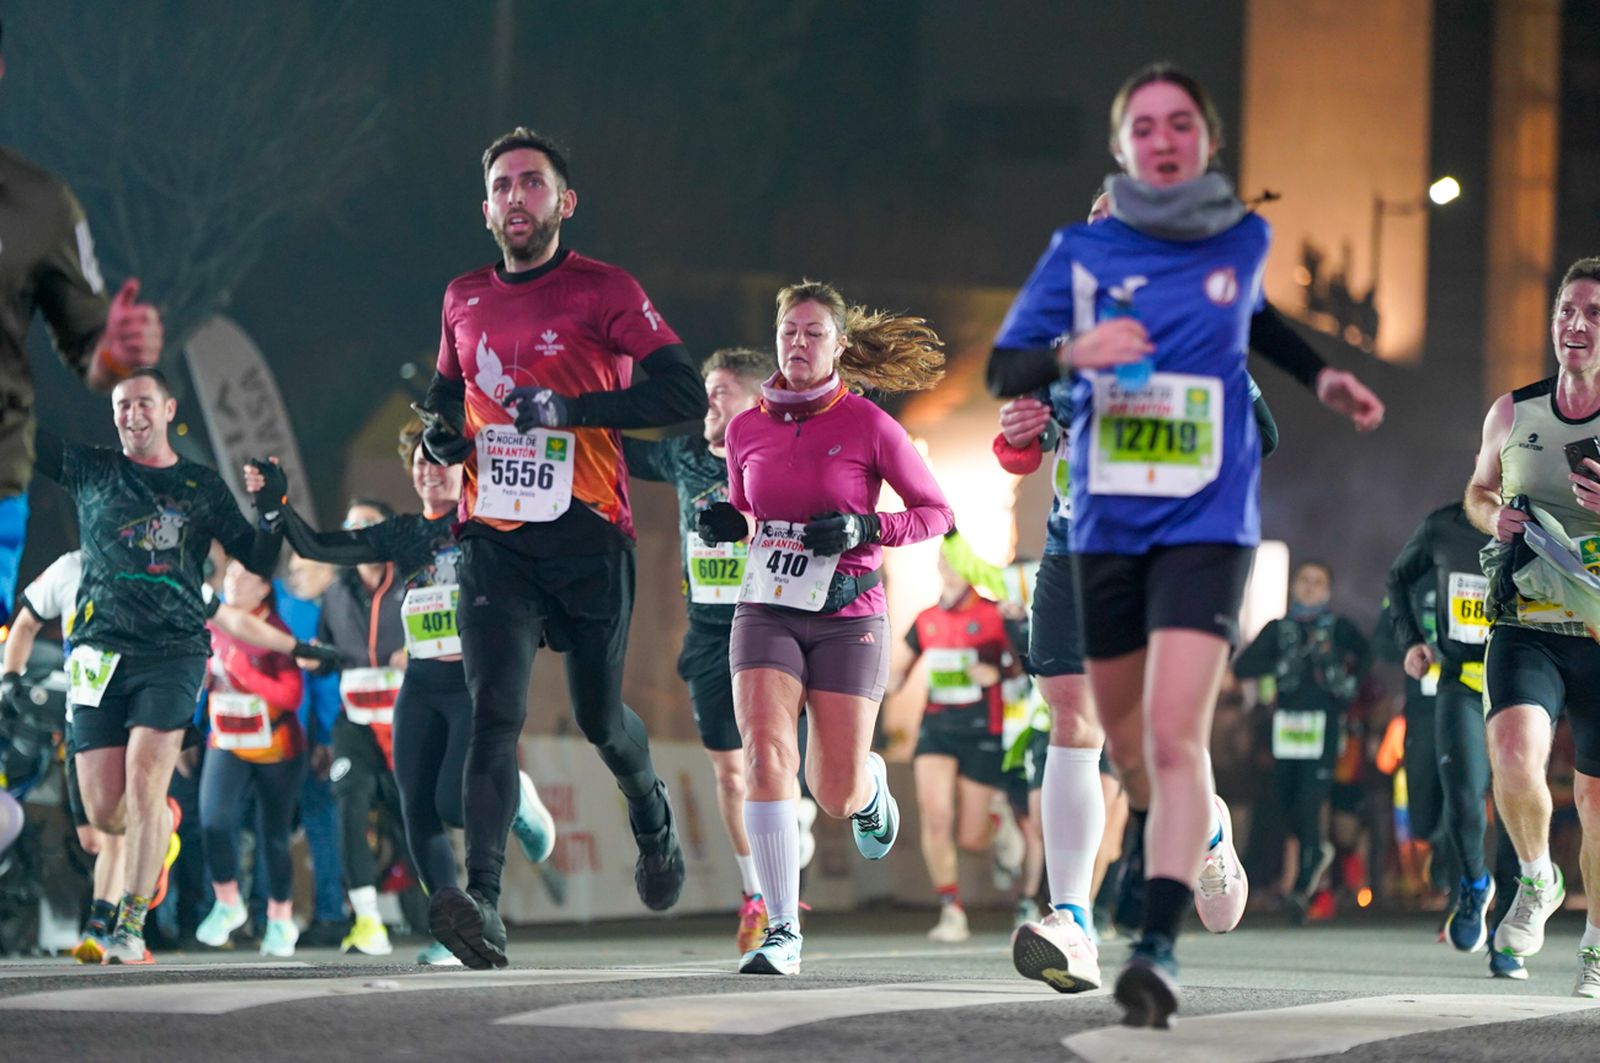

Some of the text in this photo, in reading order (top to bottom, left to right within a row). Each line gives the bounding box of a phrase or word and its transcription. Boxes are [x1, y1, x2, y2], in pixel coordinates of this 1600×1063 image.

[496, 435, 537, 447] NOCHE DE
[1115, 418, 1198, 455] 12719
[486, 445, 503, 457] SAN
[490, 458, 555, 490] 5556
[698, 558, 739, 580] 6072
[766, 550, 809, 578] 410
[1461, 600, 1484, 619] 68
